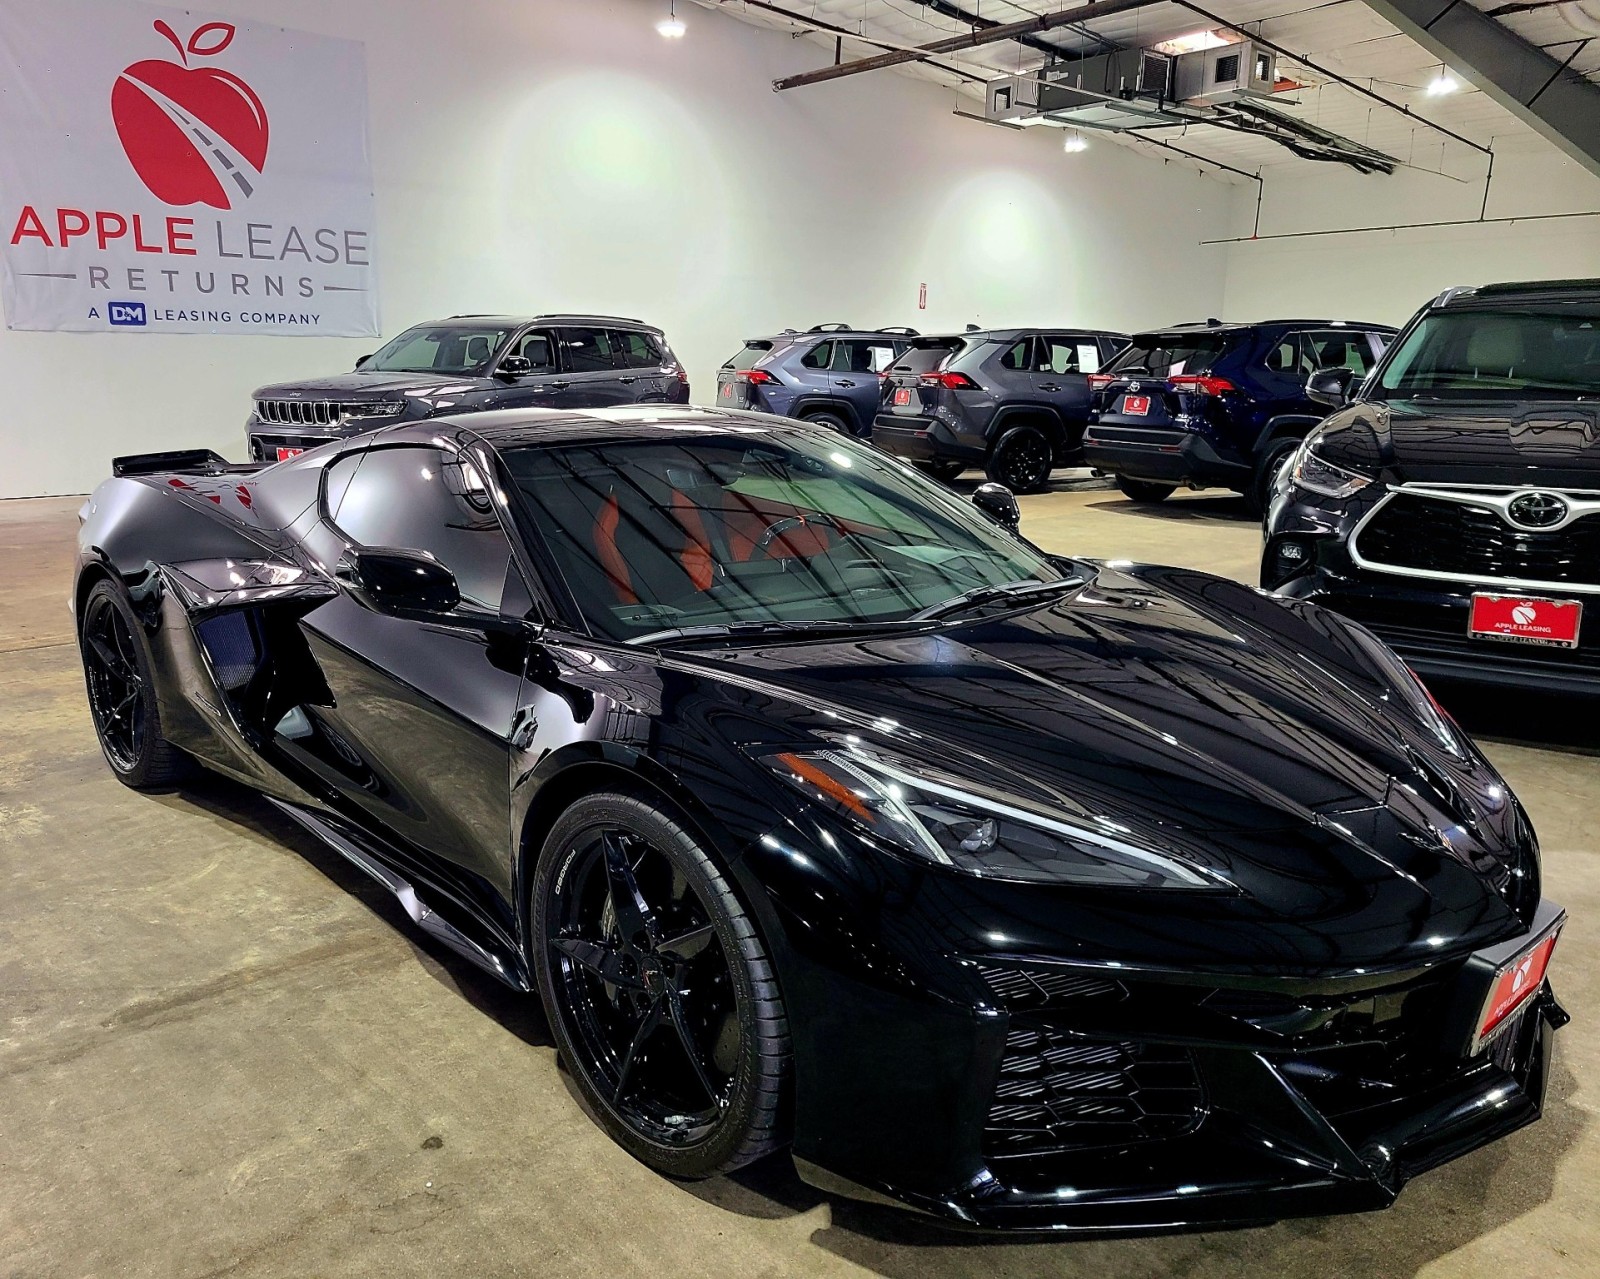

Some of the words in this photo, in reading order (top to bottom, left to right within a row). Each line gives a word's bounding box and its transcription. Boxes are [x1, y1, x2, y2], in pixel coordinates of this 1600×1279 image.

[10, 205, 198, 256] APPLE
[216, 220, 370, 266] LEASE
[88, 265, 315, 298] RETURNS
[88, 307, 100, 319] A
[154, 309, 232, 323] LEASING
[240, 312, 321, 325] COMPANY
[1494, 622, 1518, 630] APPLE
[1519, 625, 1551, 633] LEASING
[555, 849, 576, 895] FORGED
